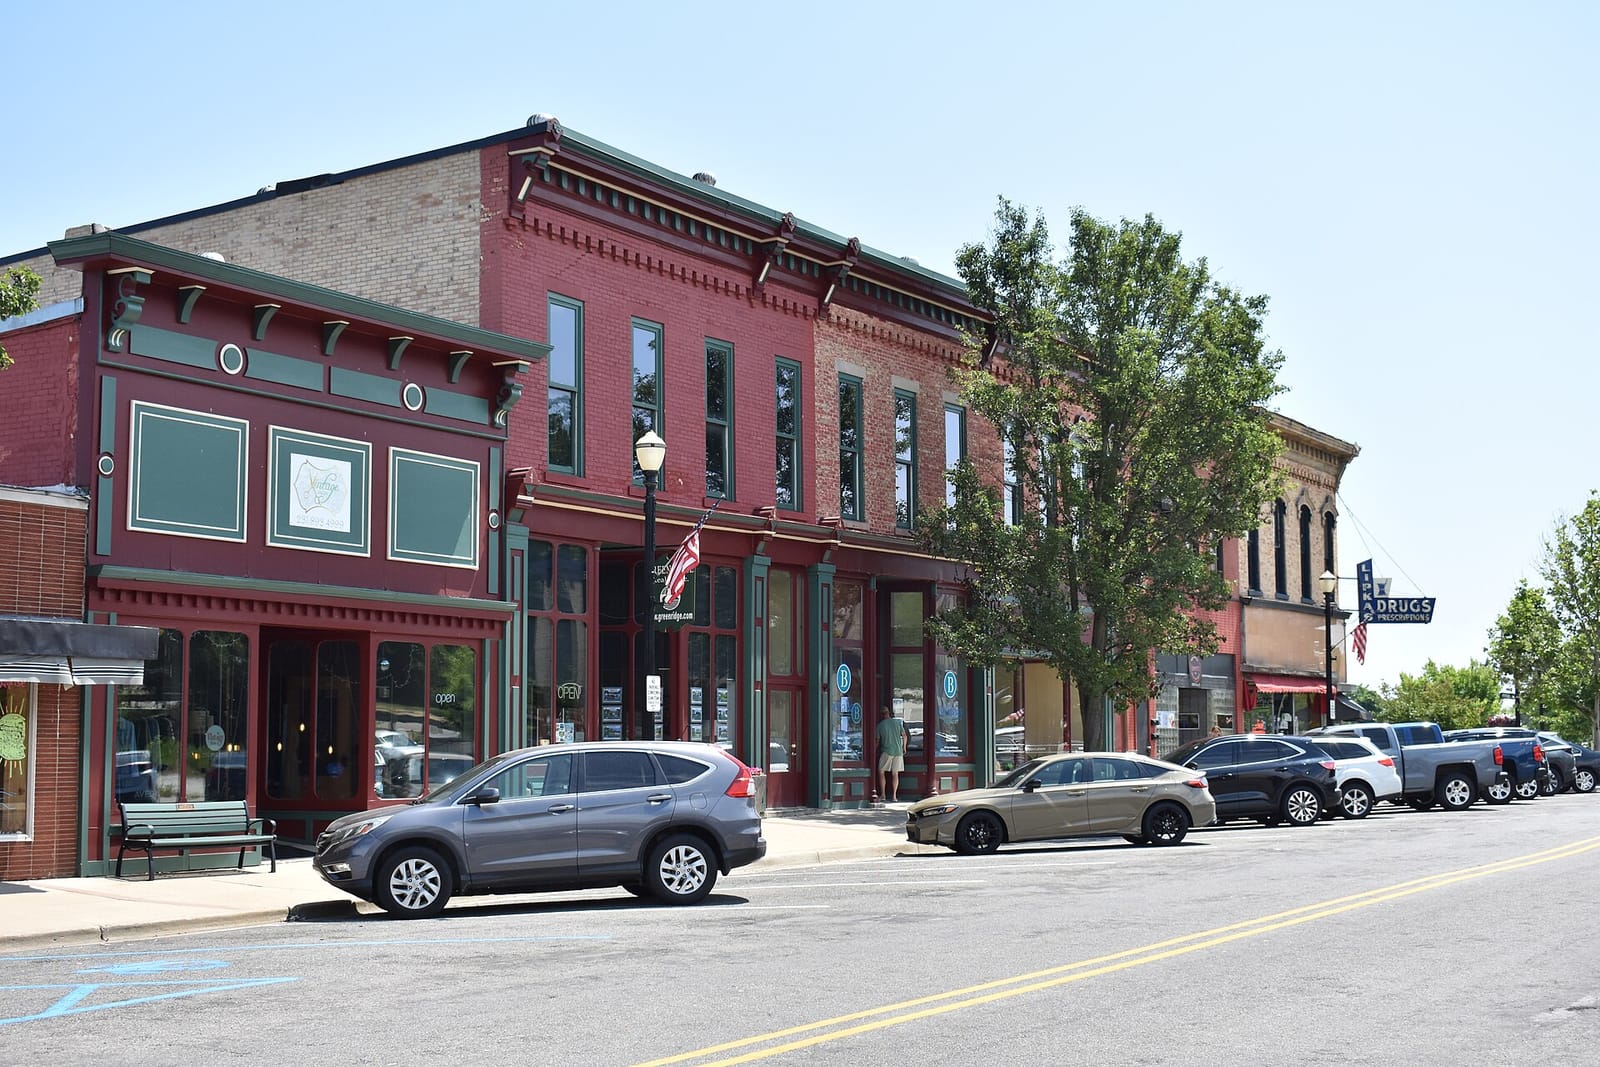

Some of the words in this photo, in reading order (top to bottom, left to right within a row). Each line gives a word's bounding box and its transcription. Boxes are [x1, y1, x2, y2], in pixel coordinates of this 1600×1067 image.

[1377, 600, 1431, 613] DRUGS
[1377, 613, 1430, 622] PRESCRIPTIONS
[558, 685, 582, 700] OPEN
[435, 693, 456, 705] open
